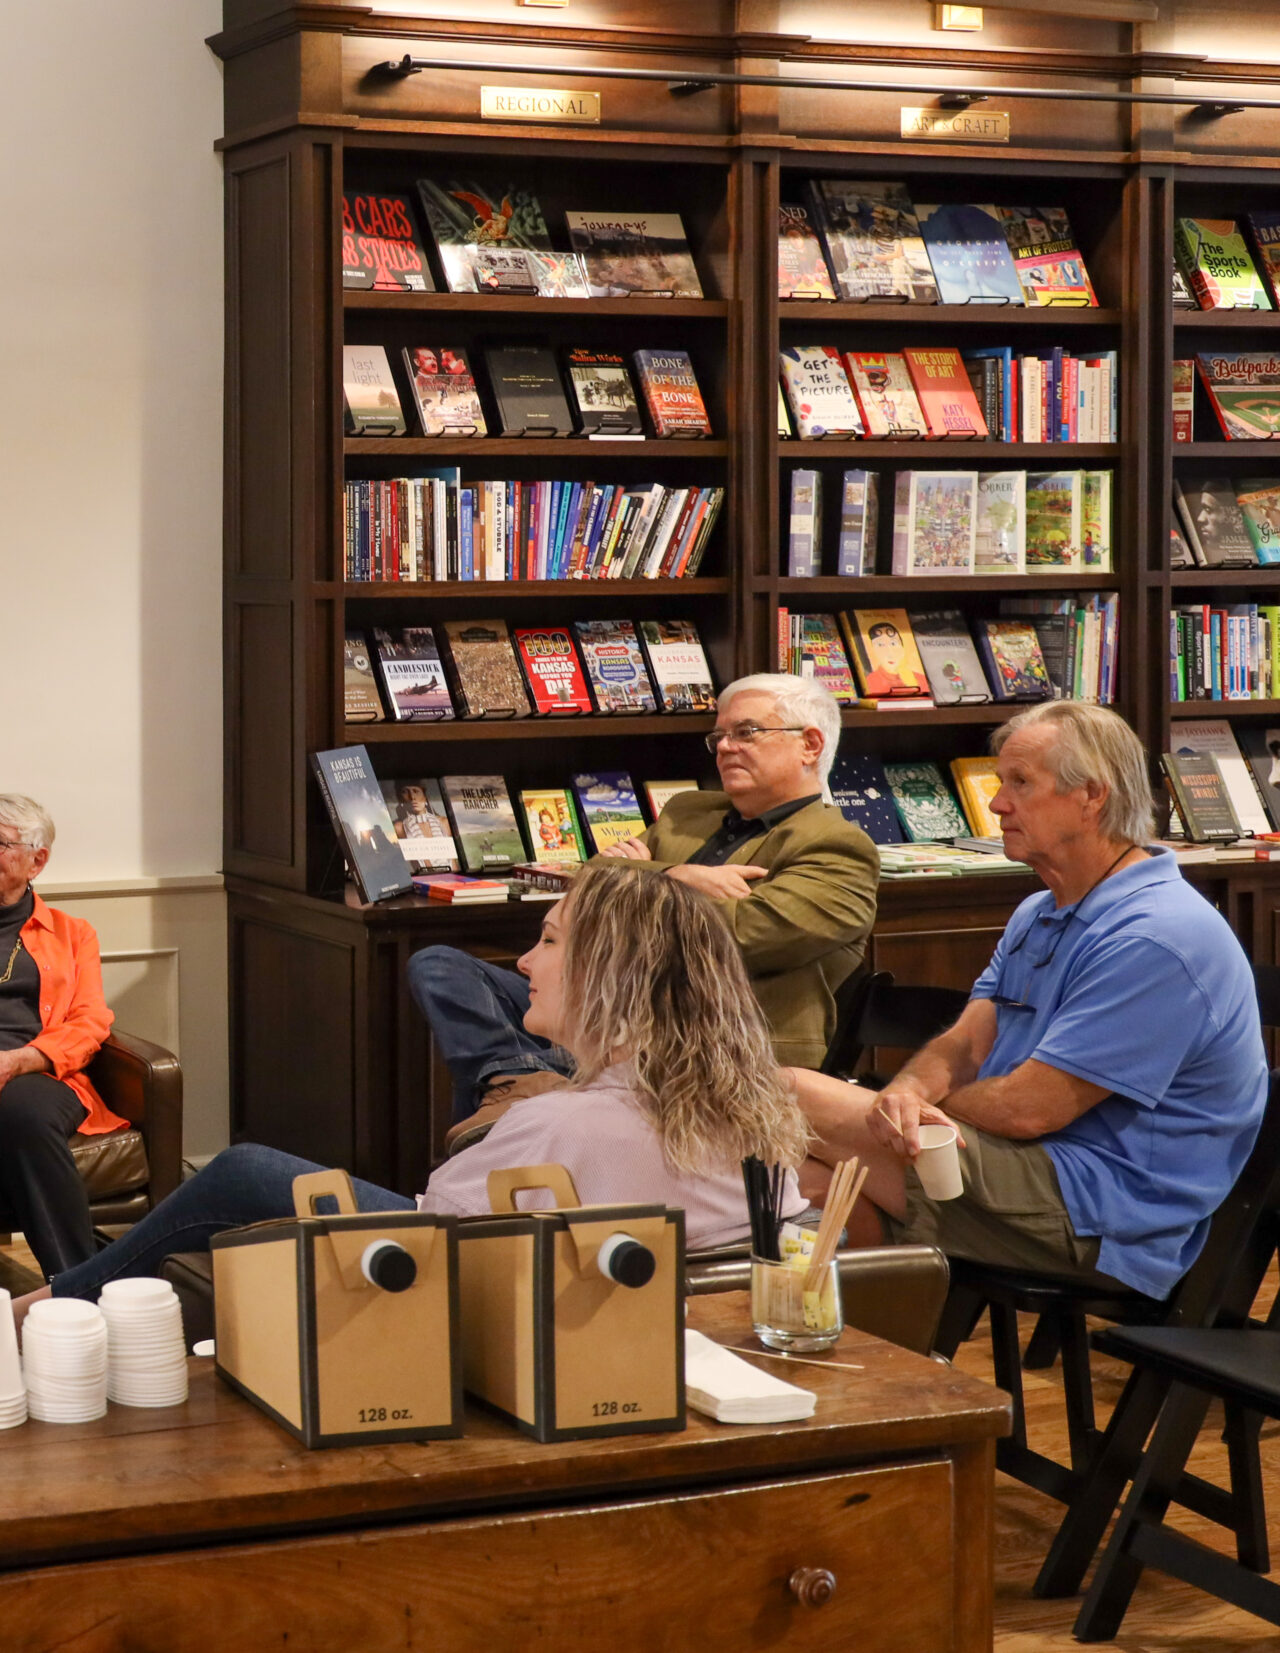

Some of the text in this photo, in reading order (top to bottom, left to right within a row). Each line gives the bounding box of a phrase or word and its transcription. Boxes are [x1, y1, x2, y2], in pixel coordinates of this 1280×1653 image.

[495, 95, 588, 115] REGIONAL
[912, 116, 939, 131] ART
[952, 117, 1001, 134] CRAFT
[355, 196, 413, 238] CARS
[580, 217, 647, 240] journeys
[358, 236, 422, 272] STATES
[1018, 239, 1073, 259] ART OF PROTEST
[1200, 242, 1224, 255] The
[1203, 255, 1248, 268] Sports
[1208, 265, 1242, 278] Book
[352, 357, 374, 371] last
[651, 357, 685, 369] BONE
[803, 358, 829, 371] GET
[912, 352, 958, 365] THE STORY
[925, 365, 955, 378] OF ART
[352, 371, 382, 387] light
[652, 374, 695, 386] OF THE
[810, 373, 831, 384] THE
[662, 391, 696, 404] BONE
[800, 385, 851, 397] PICTURE
[942, 404, 965, 417] KATY
[943, 417, 975, 429] HESSEL
[978, 482, 1013, 494] ORKER
[518, 631, 572, 657] 100
[922, 638, 968, 648] ENCOUNTERS
[598, 647, 626, 656] HISTORIC
[657, 655, 701, 663] KANSAS
[387, 663, 440, 673] CANDLESTICK
[531, 661, 576, 674] KANSAS
[544, 679, 575, 695] DIE
[330, 756, 362, 771] KANSAS IS
[333, 767, 367, 784] BEAUTIFUL
[461, 788, 496, 798] THE LAST
[463, 799, 499, 810] RANCHER
[833, 797, 866, 807] ittle one
[601, 827, 632, 837] Wheat
[358, 1407, 413, 1423] 128 oz.
[592, 1401, 642, 1417] 128 oz.
